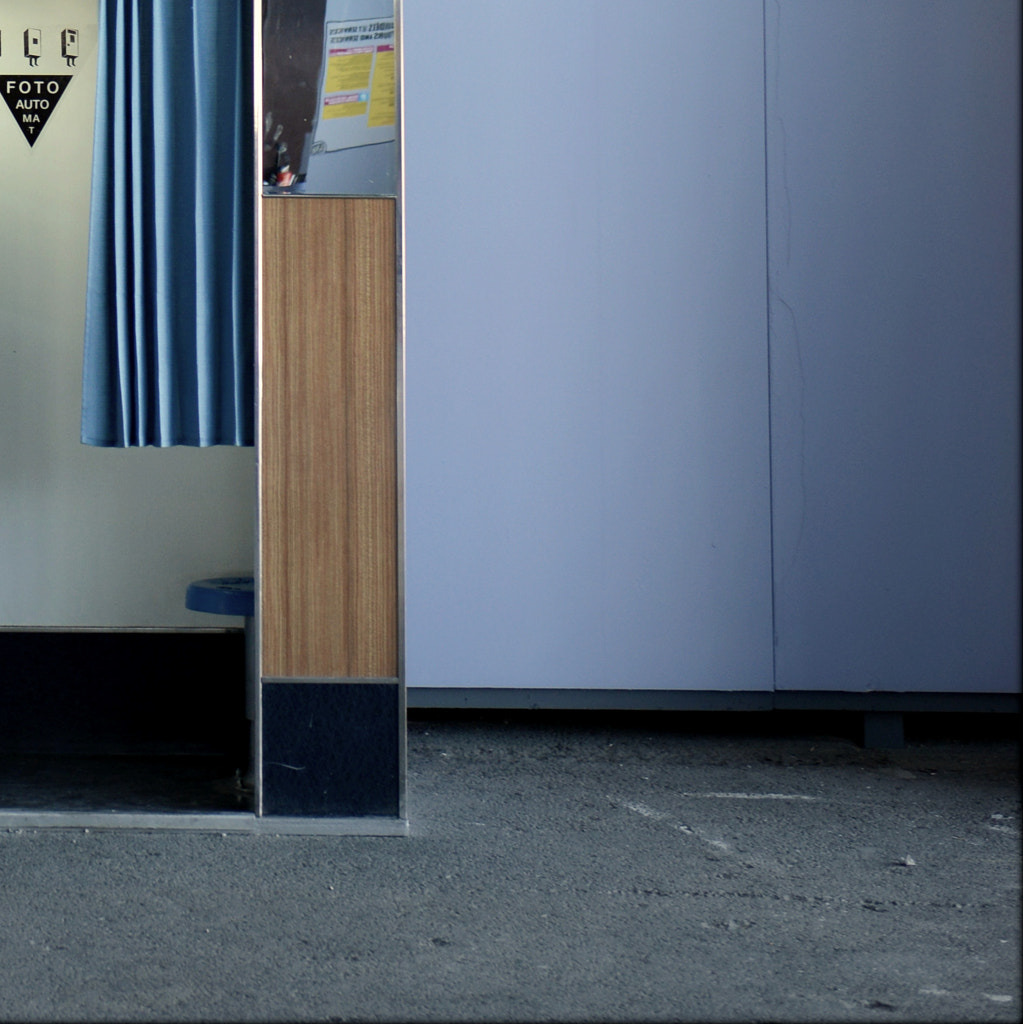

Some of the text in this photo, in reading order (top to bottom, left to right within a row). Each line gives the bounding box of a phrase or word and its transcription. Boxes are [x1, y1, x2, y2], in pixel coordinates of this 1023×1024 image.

[6, 80, 60, 94] FOTO
[15, 99, 50, 110] AUTO
[22, 114, 41, 123] MA
[28, 126, 35, 134] T
